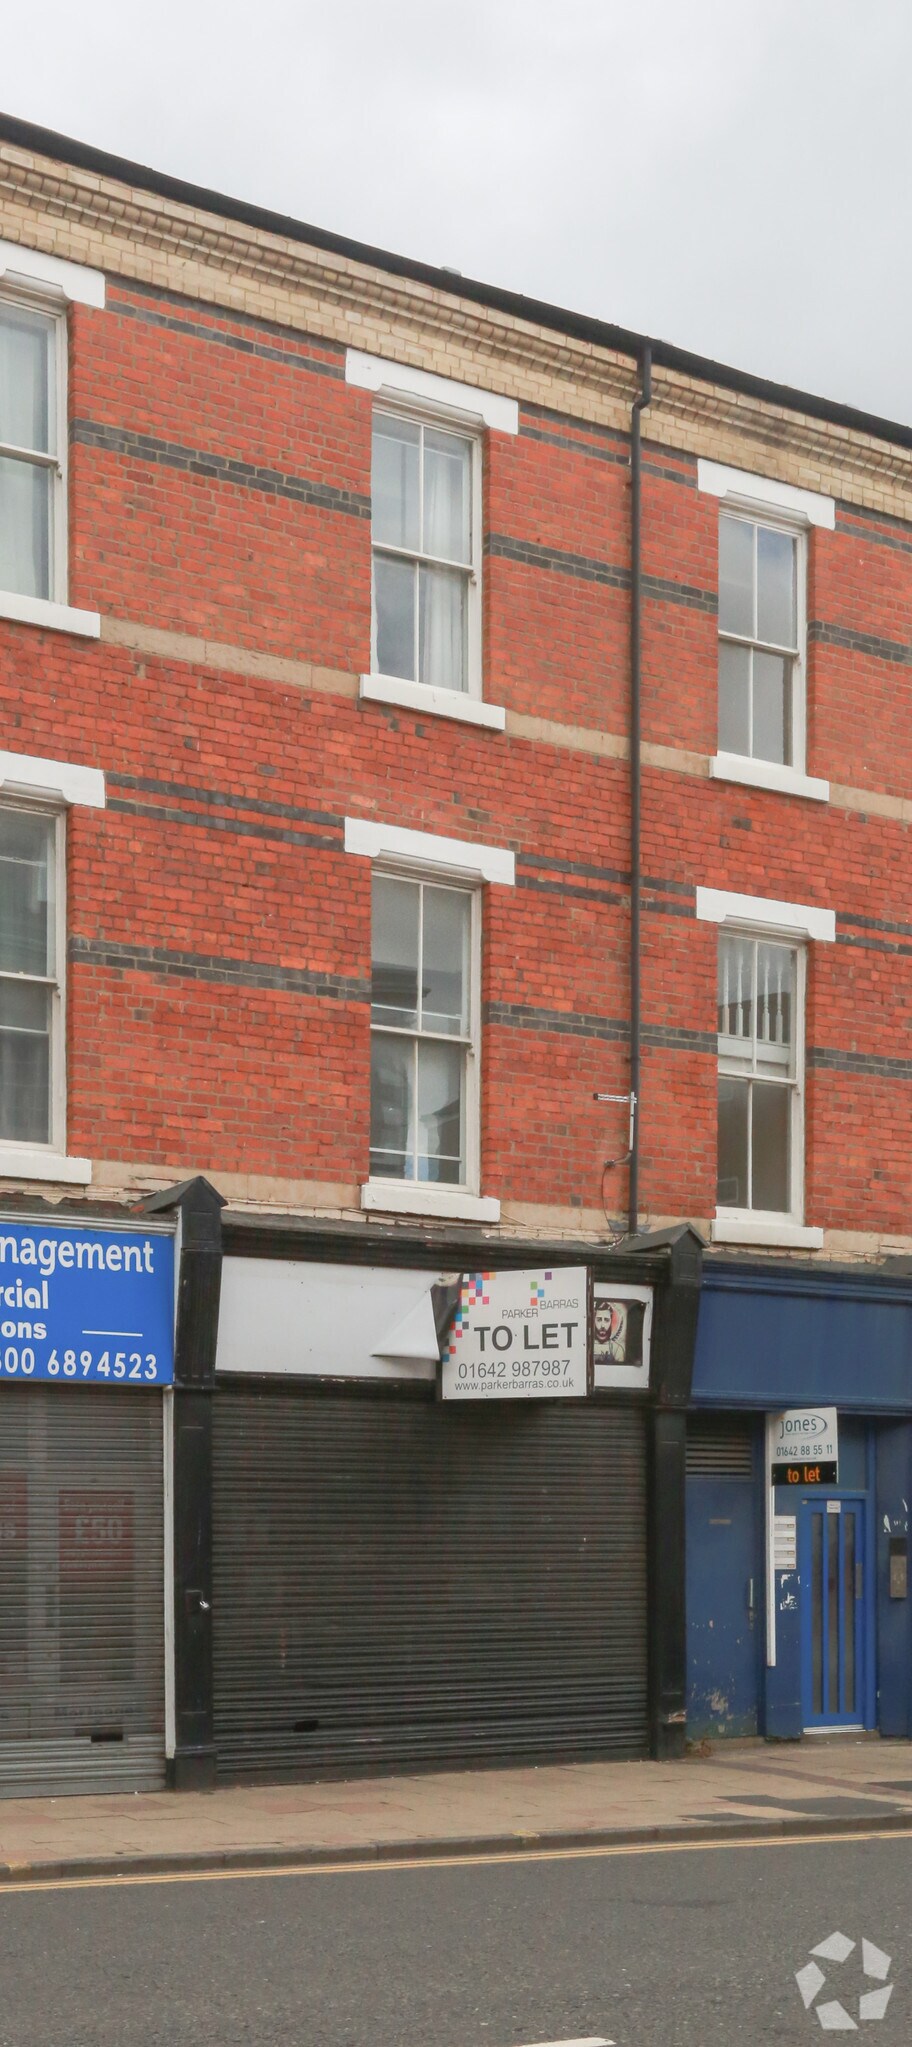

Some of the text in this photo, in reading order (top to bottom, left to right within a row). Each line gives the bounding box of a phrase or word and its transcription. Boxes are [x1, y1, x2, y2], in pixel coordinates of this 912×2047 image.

[502, 1299, 579, 1319] PARKER BARRAS
[1, 1321, 47, 1340] ons
[474, 1322, 579, 1351] TO LET
[0, 1346, 157, 1380] 00 6894523
[458, 1359, 571, 1379] 01642 987987
[454, 1377, 574, 1392] www.parkerbarras.co.uk
[780, 1418, 817, 1439] jones
[776, 1444, 833, 1456] 01642 88 55 11
[788, 1466, 820, 1482] to let
